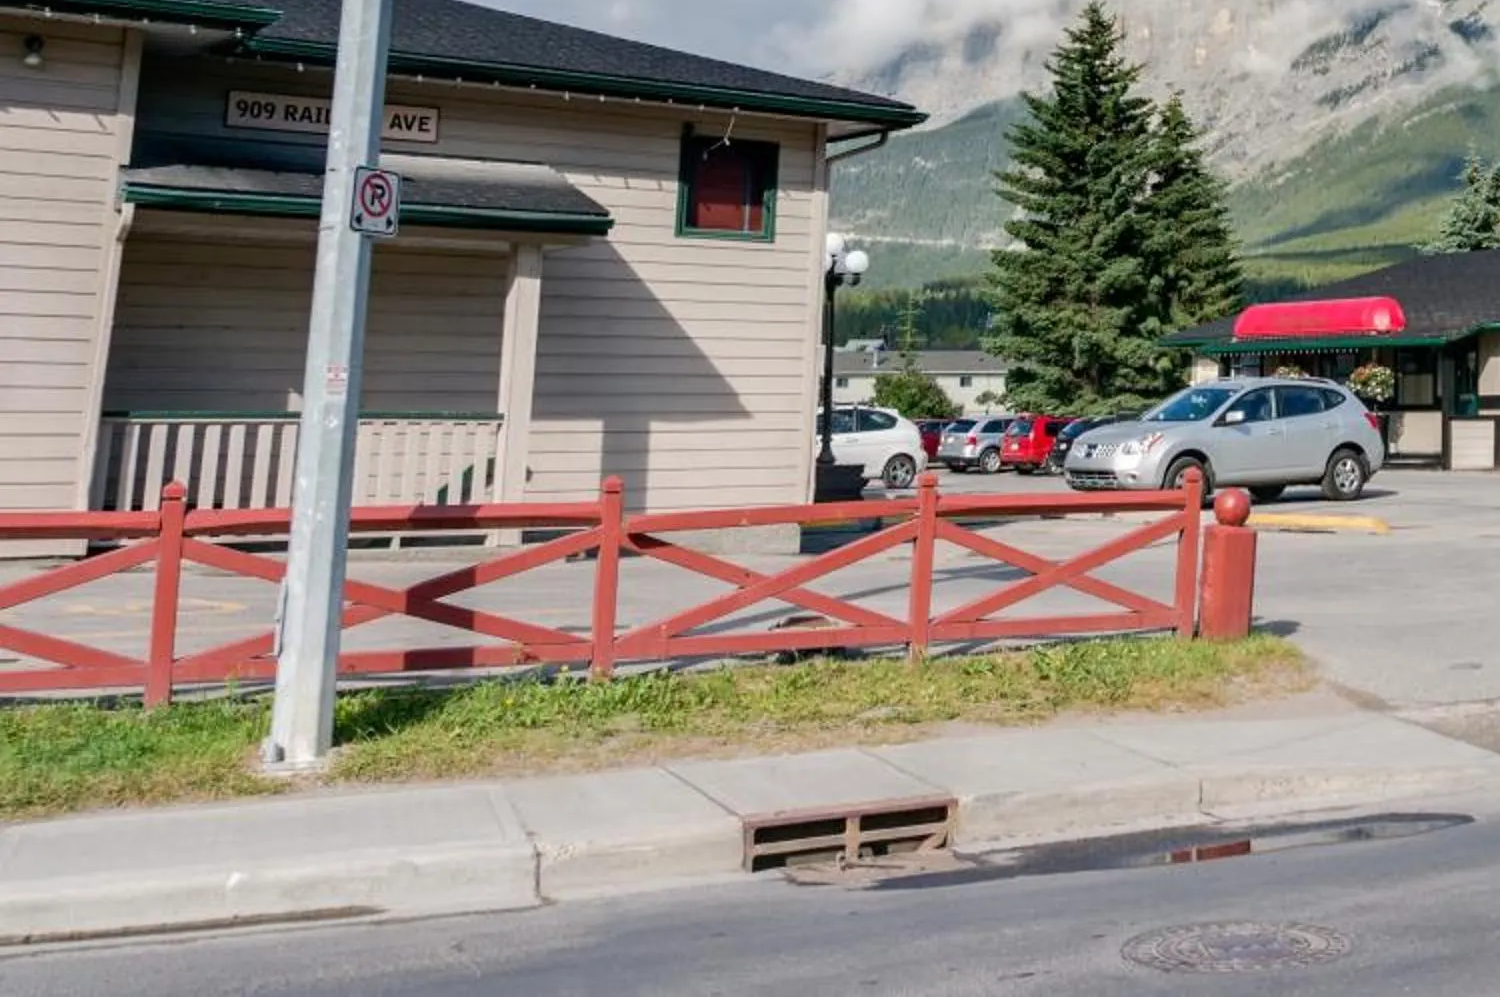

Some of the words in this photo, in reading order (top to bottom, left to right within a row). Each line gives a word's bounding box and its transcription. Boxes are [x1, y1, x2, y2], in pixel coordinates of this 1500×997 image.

[236, 99, 276, 120] 909
[284, 104, 331, 125] RAIL
[389, 113, 432, 132] AVE
